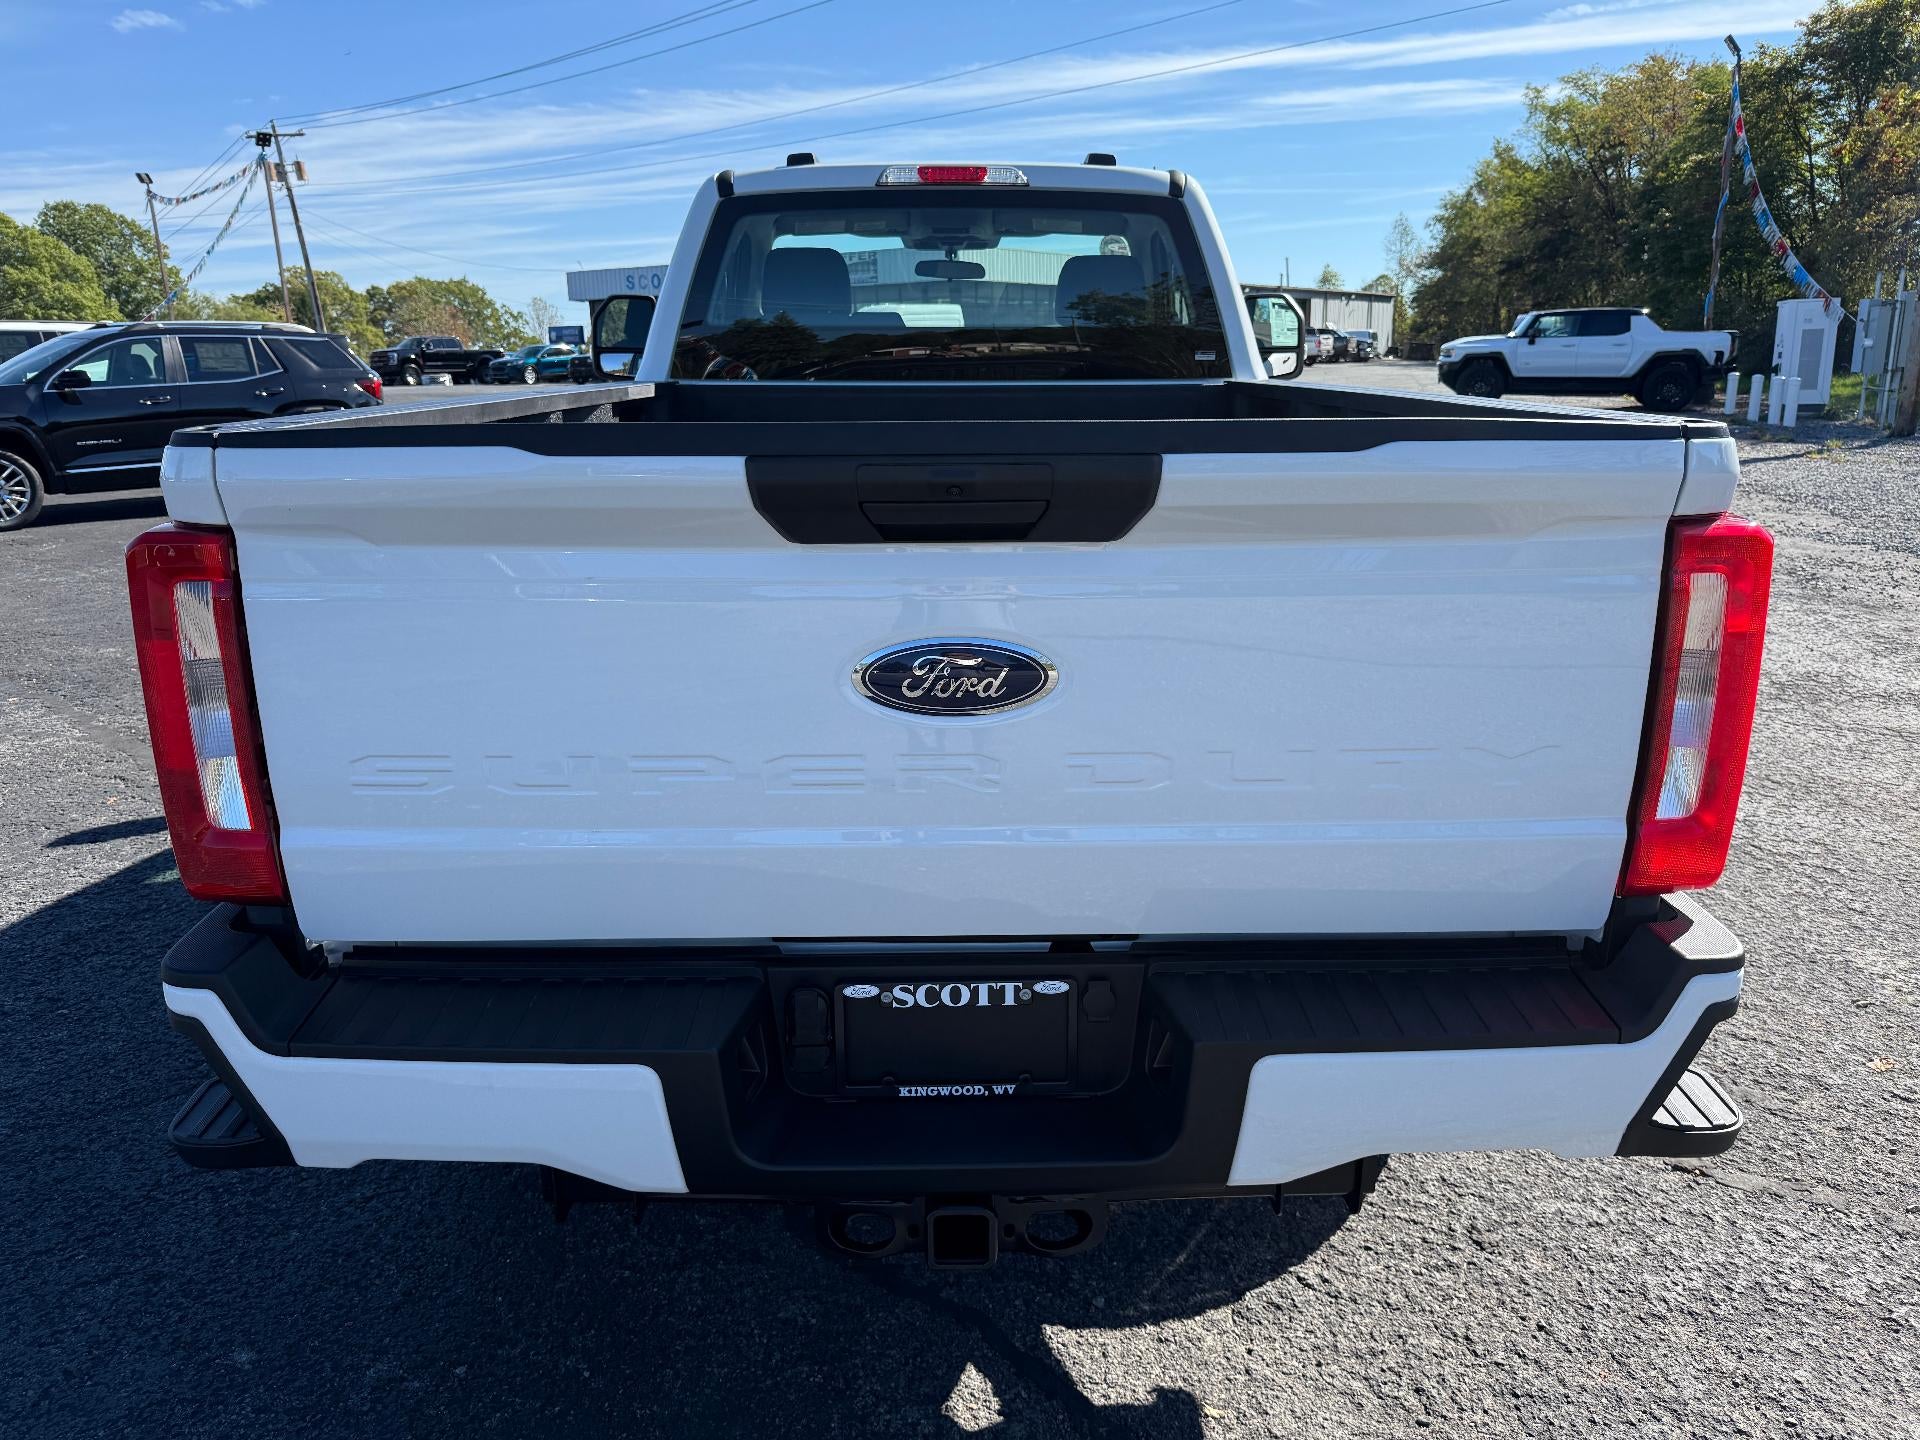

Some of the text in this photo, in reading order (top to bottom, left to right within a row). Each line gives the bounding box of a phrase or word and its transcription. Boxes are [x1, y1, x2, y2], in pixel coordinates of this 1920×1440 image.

[901, 655, 1010, 699] Ford
[349, 745, 1561, 796] SUPER DUTY
[849, 986, 873, 997] Ford
[892, 982, 1023, 1009] SCOTT
[1039, 982, 1063, 993] Ford
[898, 1084, 1017, 1097] KINGWOOD, WV
